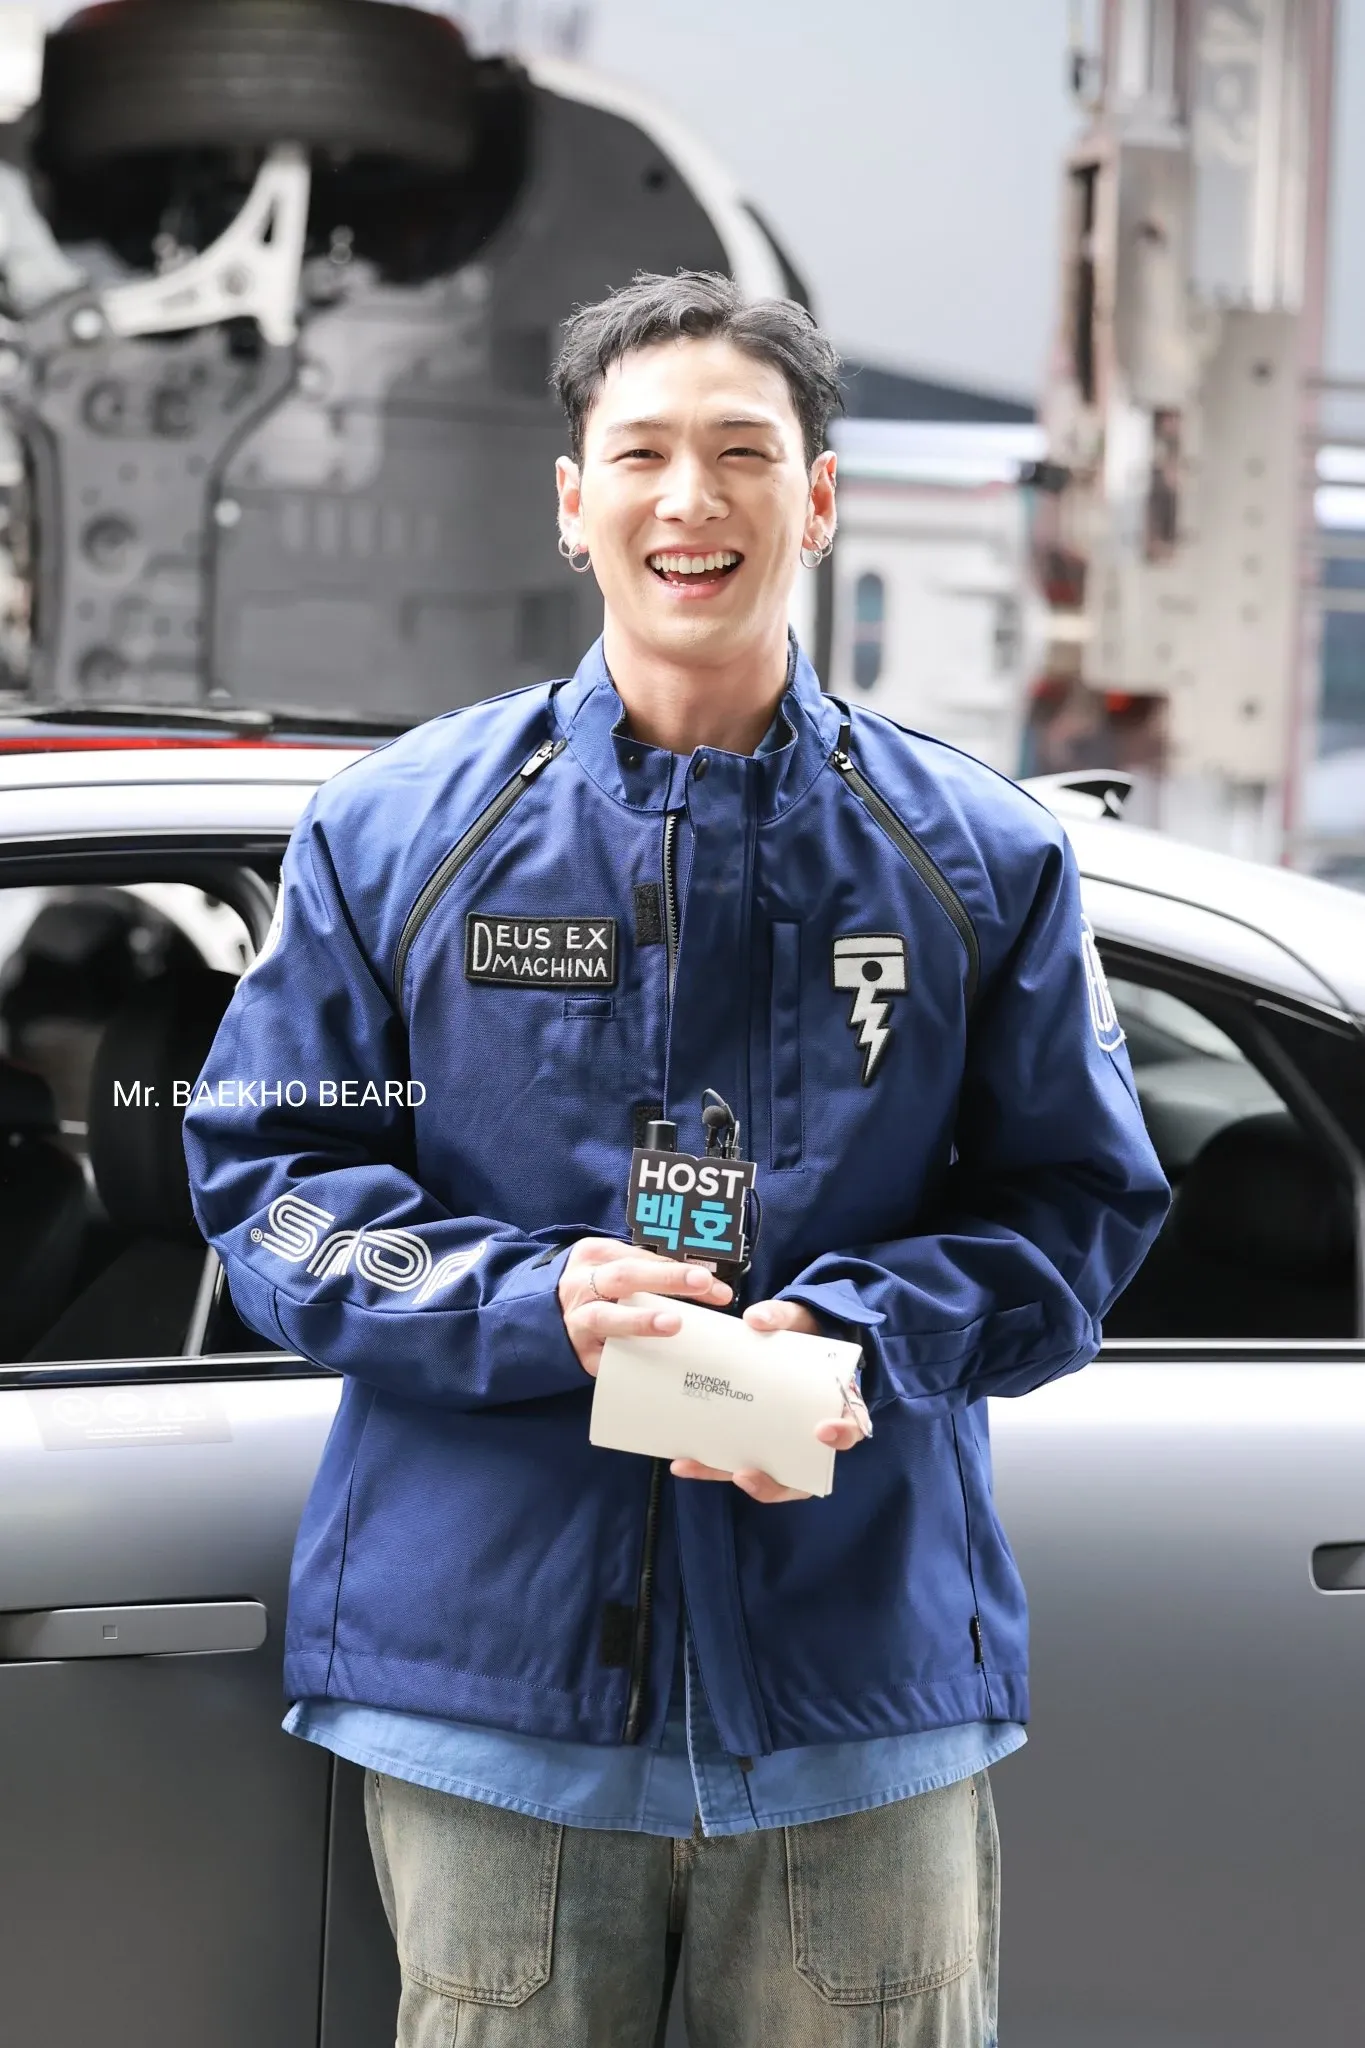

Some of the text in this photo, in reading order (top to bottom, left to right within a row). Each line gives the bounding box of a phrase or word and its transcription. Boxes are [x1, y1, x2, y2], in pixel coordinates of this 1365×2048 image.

[473, 922, 608, 972] DEUS EX
[492, 953, 608, 978] MACHINA
[638, 1159, 744, 1199] HOST
[635, 1192, 733, 1251] 백호
[683, 1380, 754, 1402] MOTORSTUDIO
[685, 1371, 730, 1389] HYUNDAI
